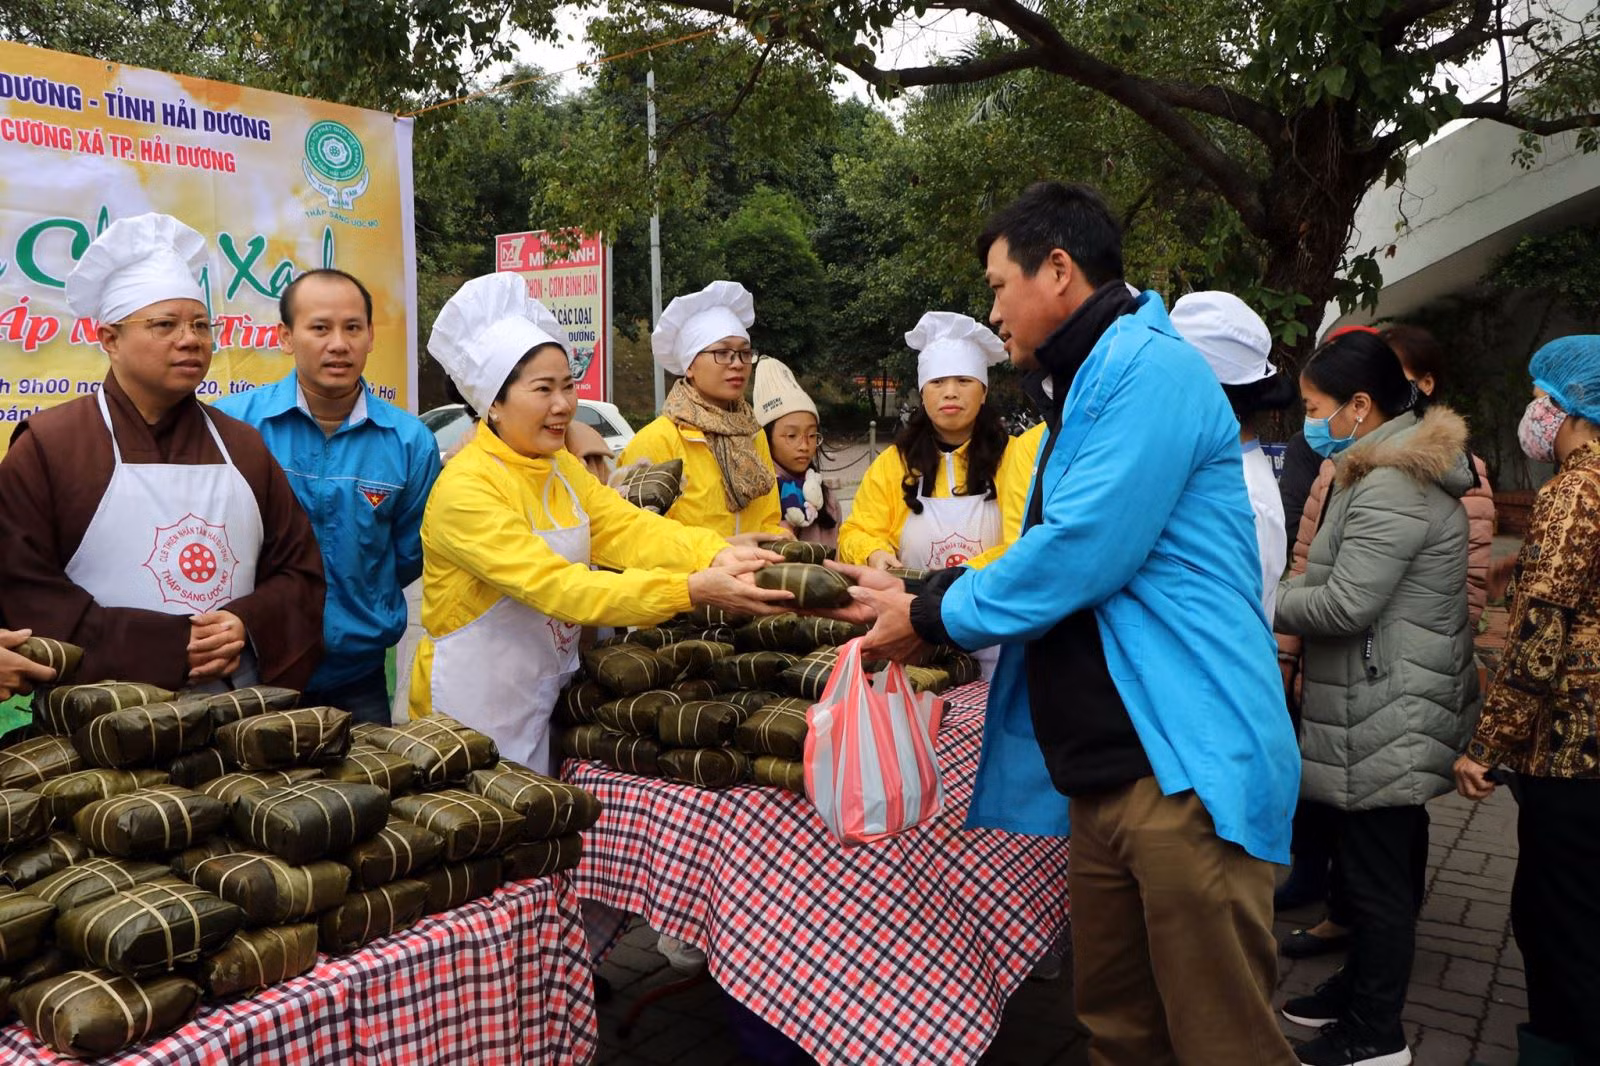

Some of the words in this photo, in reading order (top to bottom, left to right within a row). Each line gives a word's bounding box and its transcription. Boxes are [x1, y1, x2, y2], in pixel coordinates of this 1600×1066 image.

[0, 73, 82, 111] DƯƠNG
[104, 87, 155, 123] TỈNH
[162, 99, 197, 130] HẢI
[203, 109, 271, 141] DƯƠNG
[1, 117, 73, 151] CƯƠNG
[77, 128, 105, 155] XÁ
[109, 135, 135, 160] TP.
[140, 135, 171, 164] HẢI
[176, 145, 236, 173] DƯƠNG
[214, 314, 280, 348] Tìn
[558, 303, 573, 325] CÁC
[574, 307, 592, 329] LOẠI
[19, 379, 70, 394] 9h00
[379, 385, 396, 402] Hợi
[180, 589, 206, 602] SÁNG
